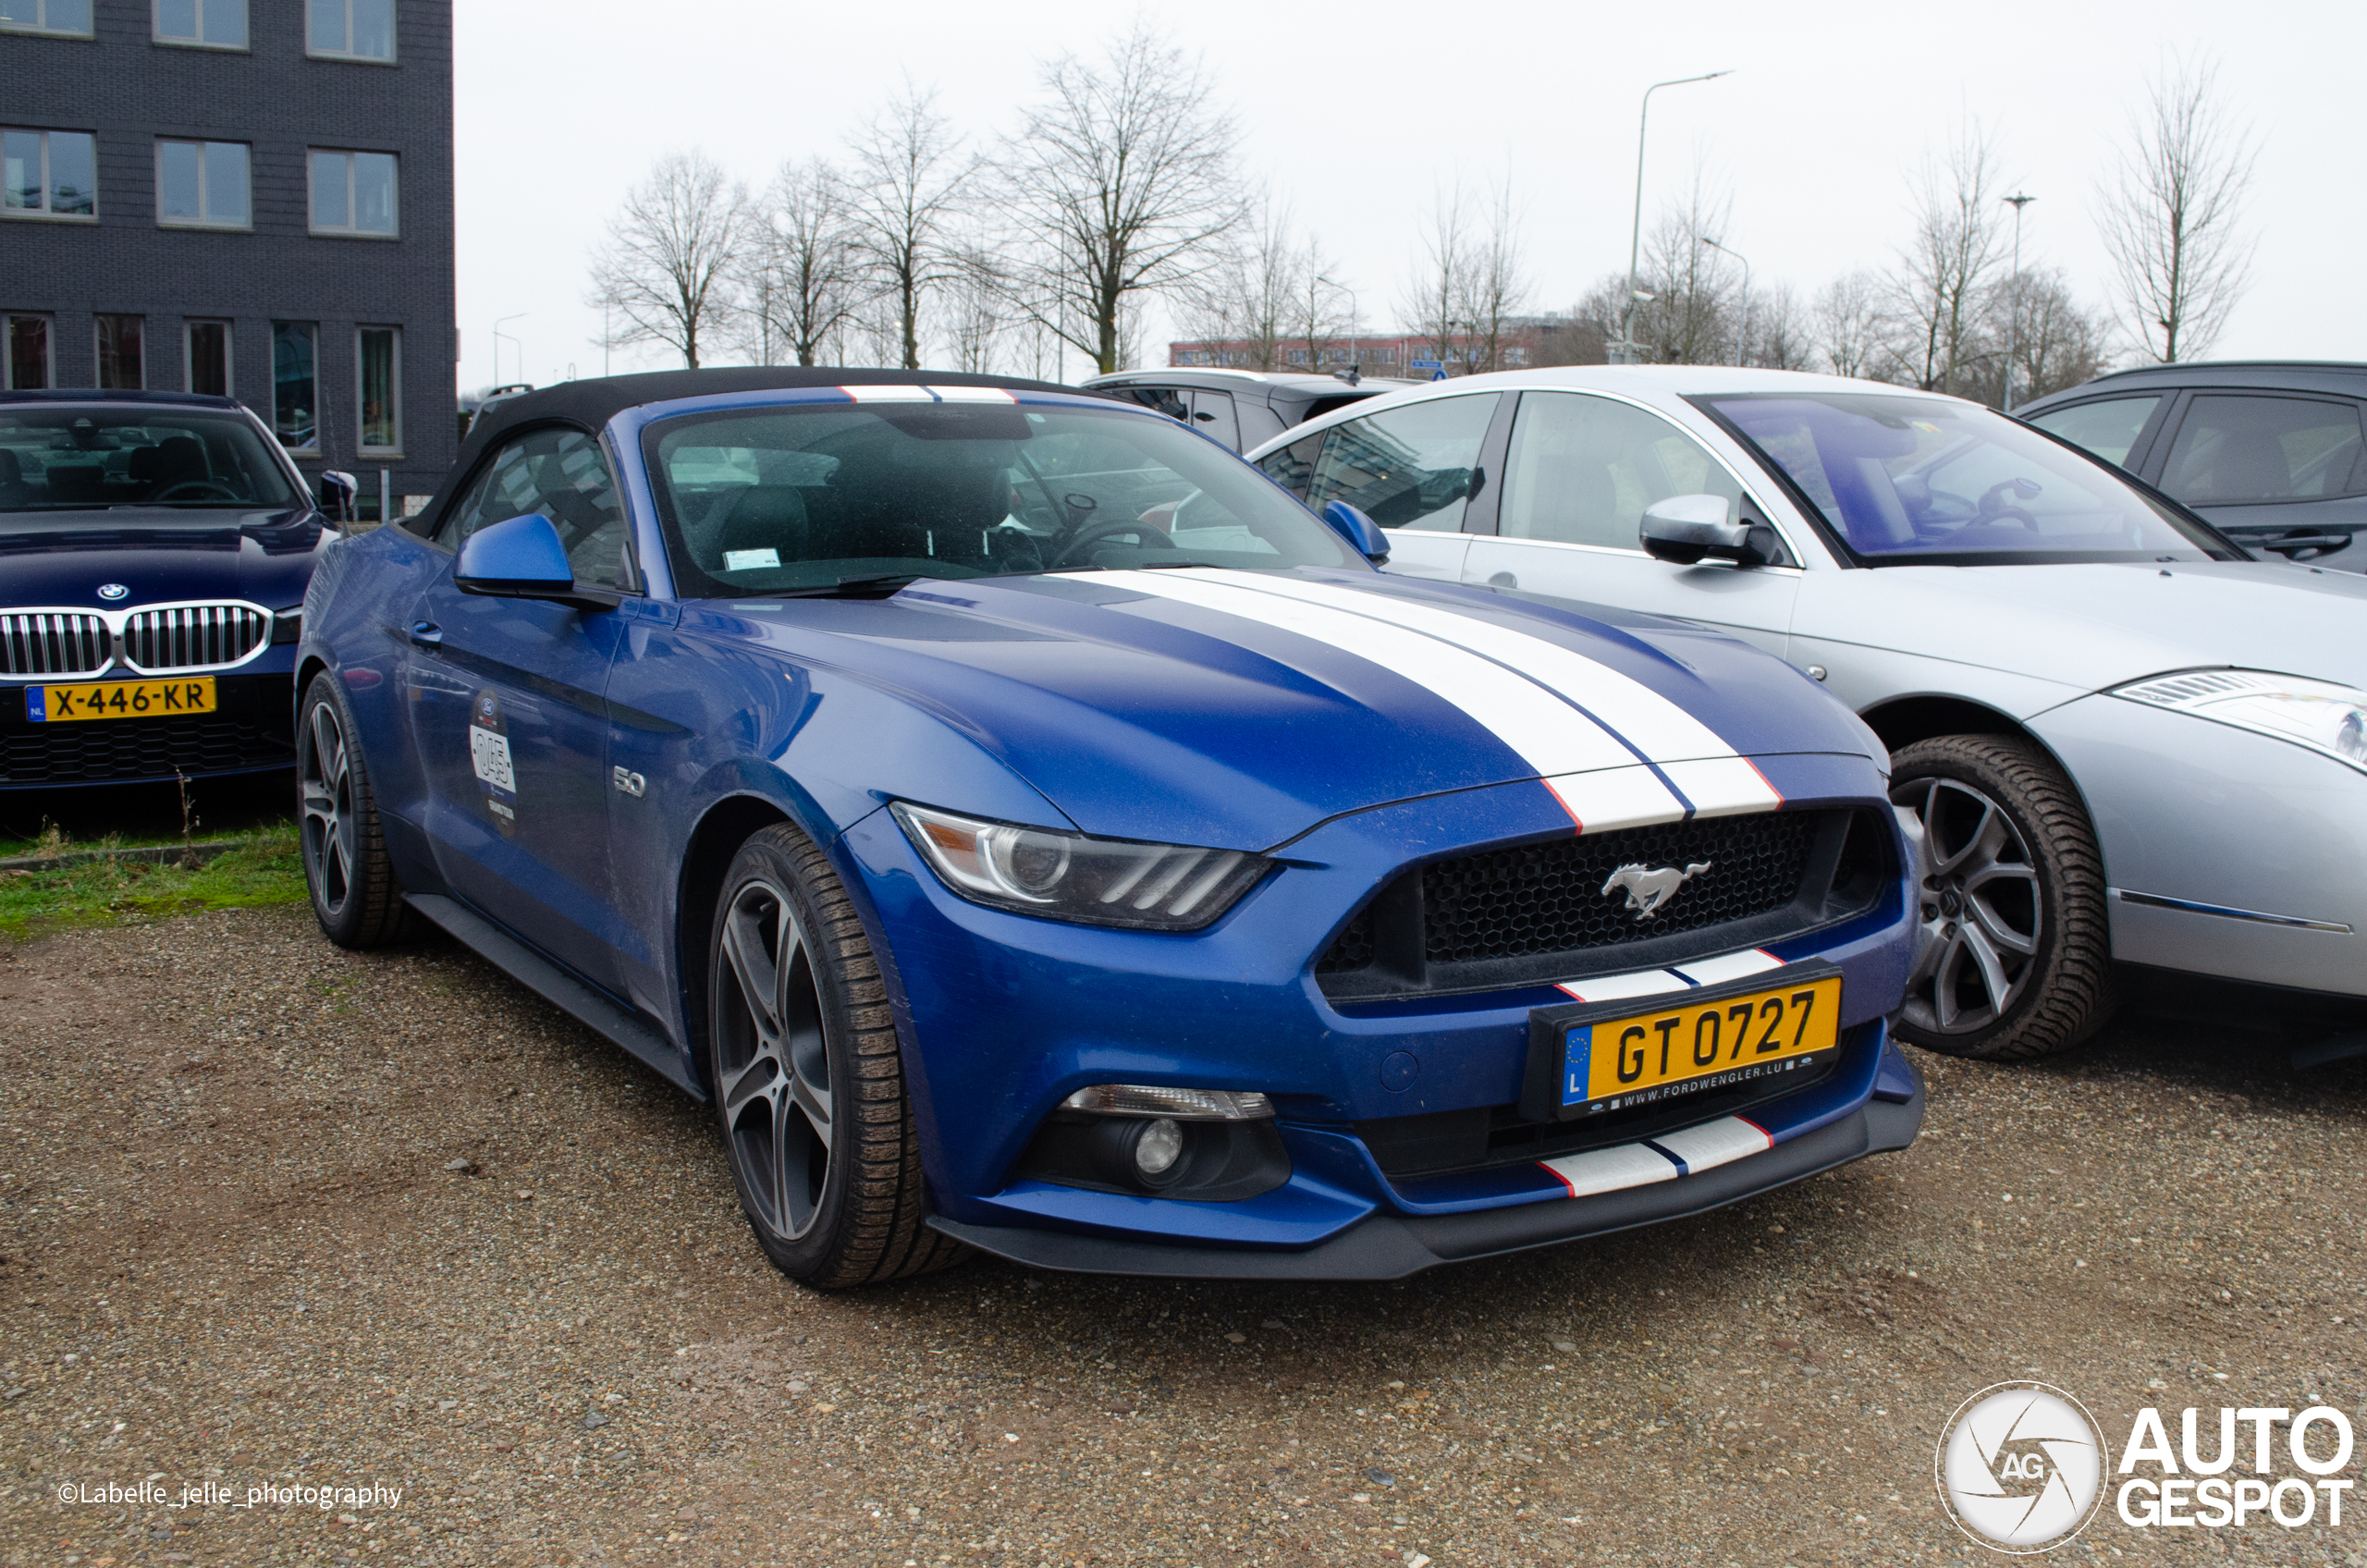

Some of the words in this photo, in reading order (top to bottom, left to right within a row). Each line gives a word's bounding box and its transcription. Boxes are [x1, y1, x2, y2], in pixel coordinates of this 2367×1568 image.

[31, 707, 44, 716] NL
[55, 683, 205, 717] X-446-KR
[476, 733, 508, 784] 045
[1617, 1015, 1681, 1084] GT
[1693, 989, 1815, 1066] 0727
[1569, 1073, 1580, 1093] L
[1625, 1062, 1783, 1107] WWW.FORDWENGLER.LU
